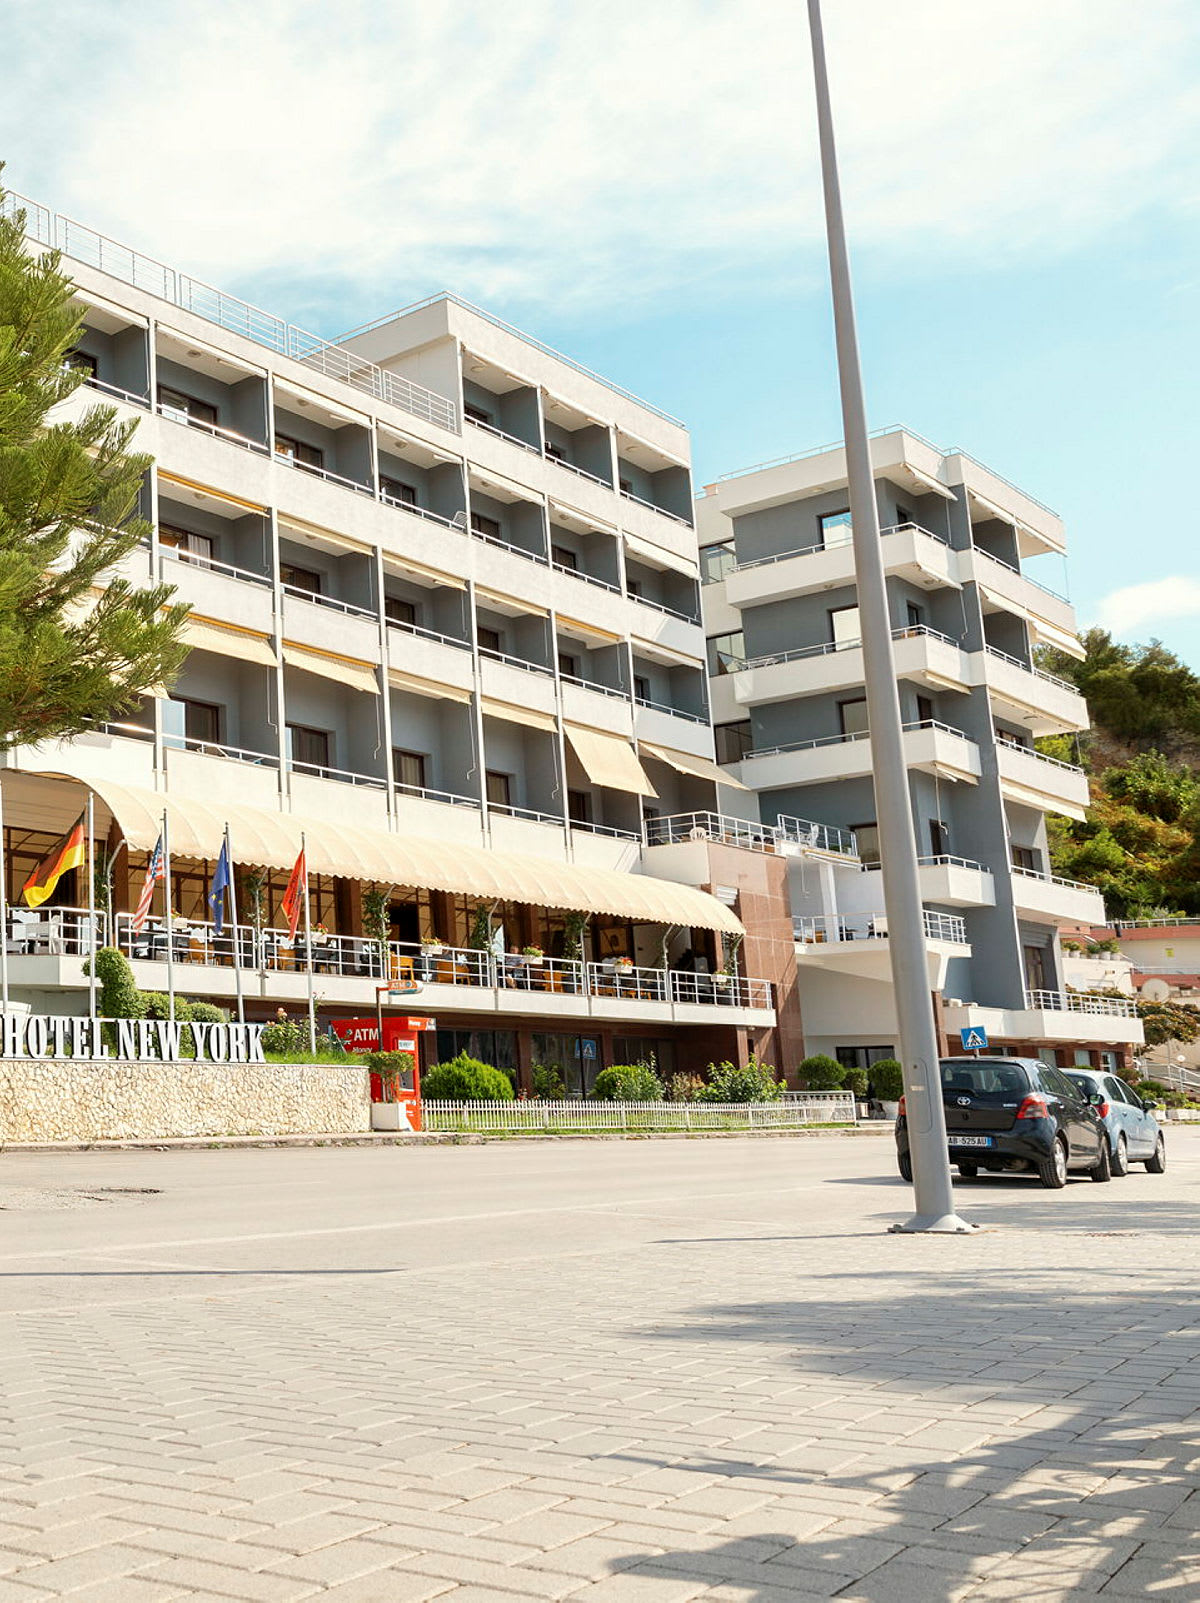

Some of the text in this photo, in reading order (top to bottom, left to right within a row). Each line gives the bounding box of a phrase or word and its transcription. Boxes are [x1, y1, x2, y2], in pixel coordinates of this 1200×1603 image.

[0, 1014, 267, 1064] HOTEL NEW YORK
[353, 1028, 380, 1042] ATM
